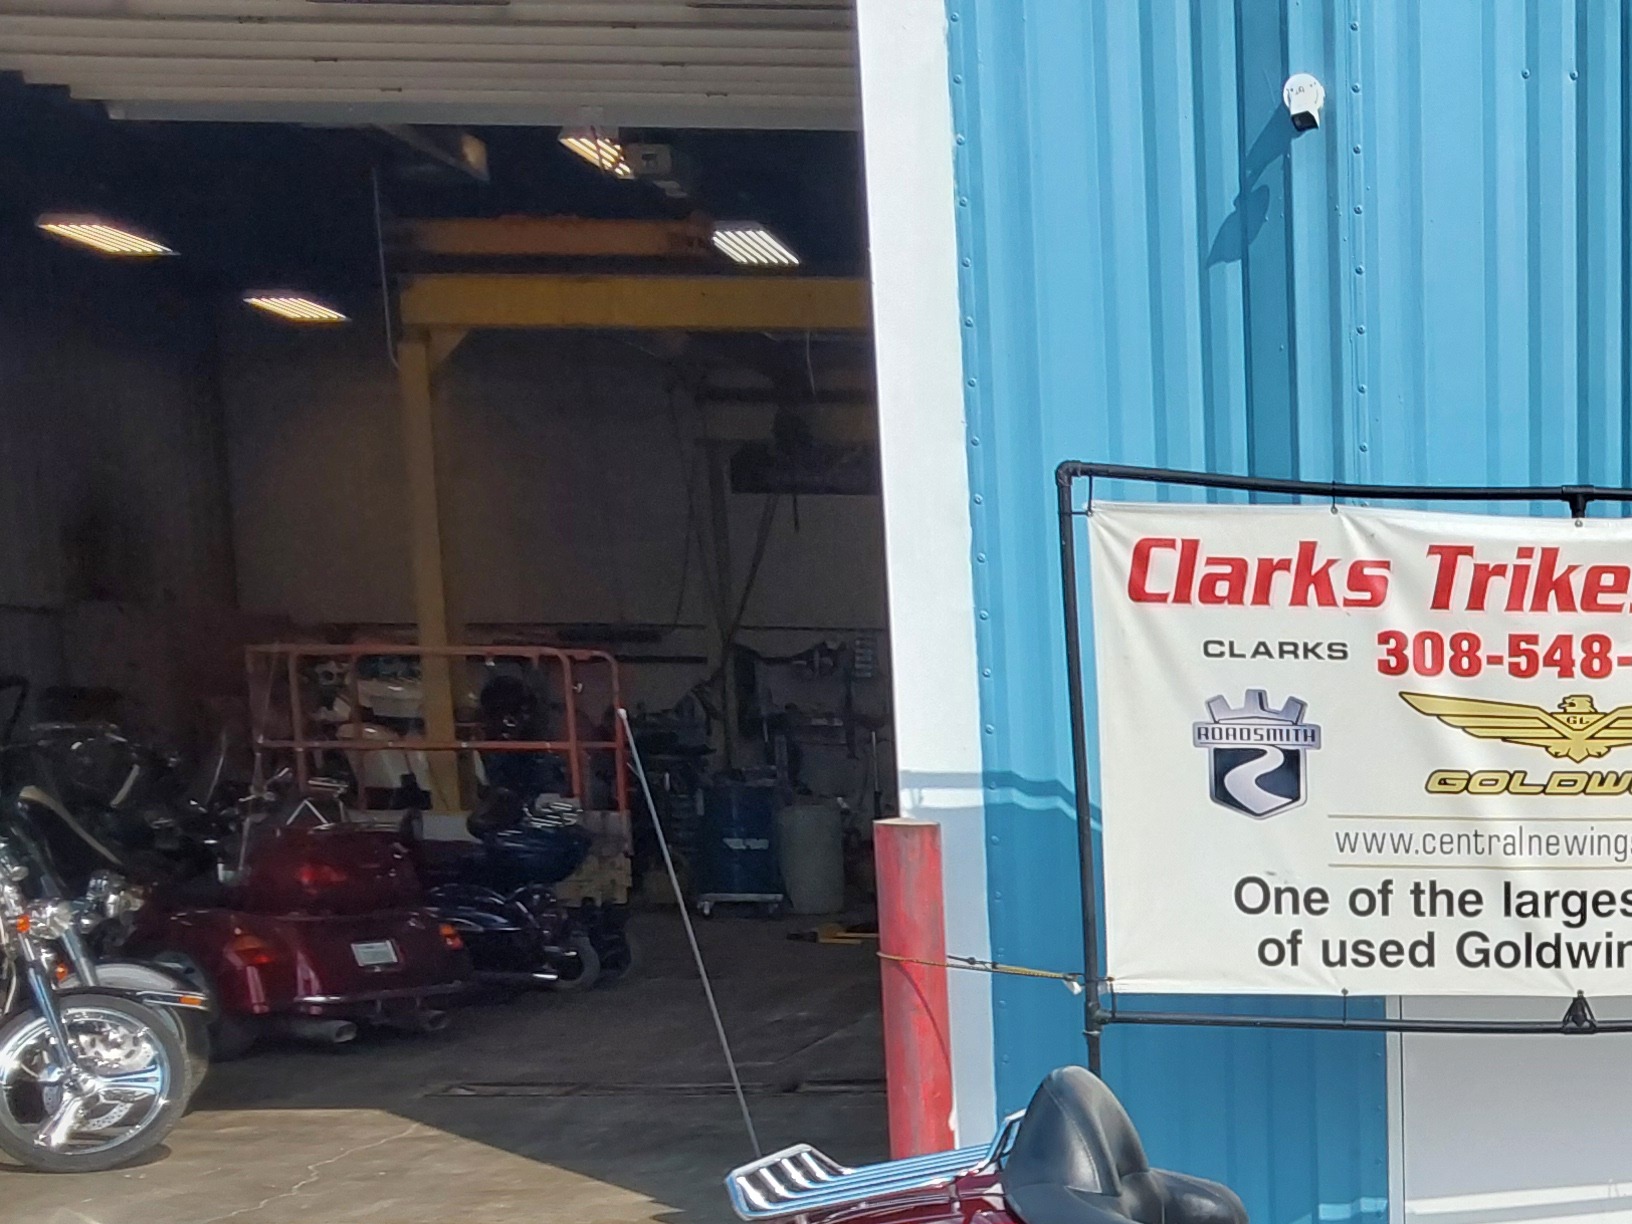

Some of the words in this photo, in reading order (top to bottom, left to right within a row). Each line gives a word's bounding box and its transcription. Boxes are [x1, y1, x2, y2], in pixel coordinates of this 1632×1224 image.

[1128, 538, 1391, 607] Clarks
[1203, 640, 1348, 660] CLARKS
[1197, 727, 1315, 742] ROADSMITH
[1566, 716, 1590, 724] GL
[1234, 876, 1330, 916] One
[1348, 879, 1393, 917] of
[1410, 880, 1484, 917] the
[1257, 929, 1302, 966] of
[1321, 931, 1435, 967] used
